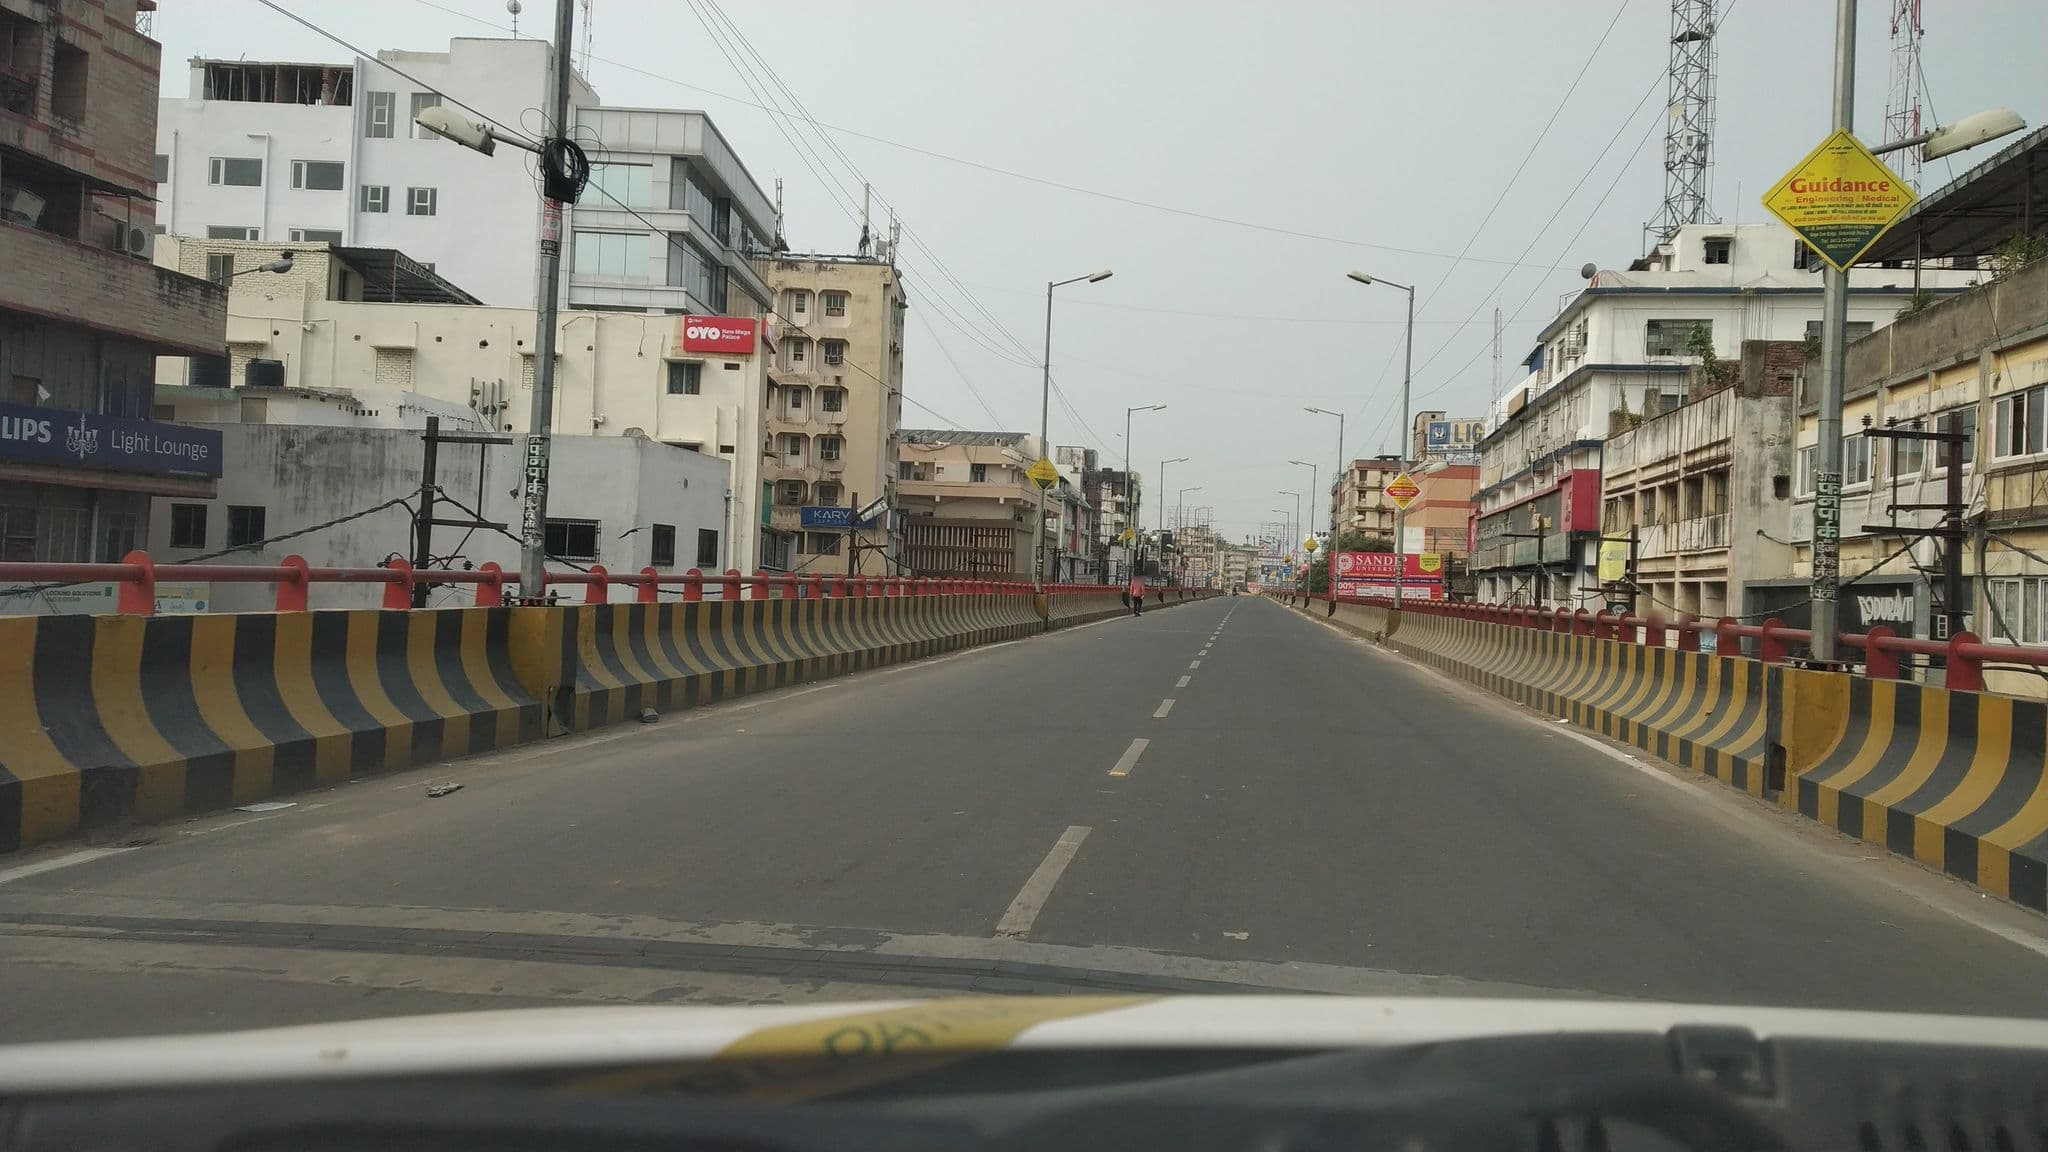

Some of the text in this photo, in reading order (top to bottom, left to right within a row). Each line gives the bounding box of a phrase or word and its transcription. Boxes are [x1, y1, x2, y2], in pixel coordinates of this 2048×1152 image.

[1790, 177, 1890, 193] Guidance
[1796, 196, 1854, 204] Engineering
[686, 326, 720, 340] OYO
[1454, 422, 1484, 442] LIC
[111, 430, 150, 454] Light
[154, 435, 208, 461] Lounge
[814, 510, 850, 519] KARV
[1337, 582, 1355, 590] 00%
